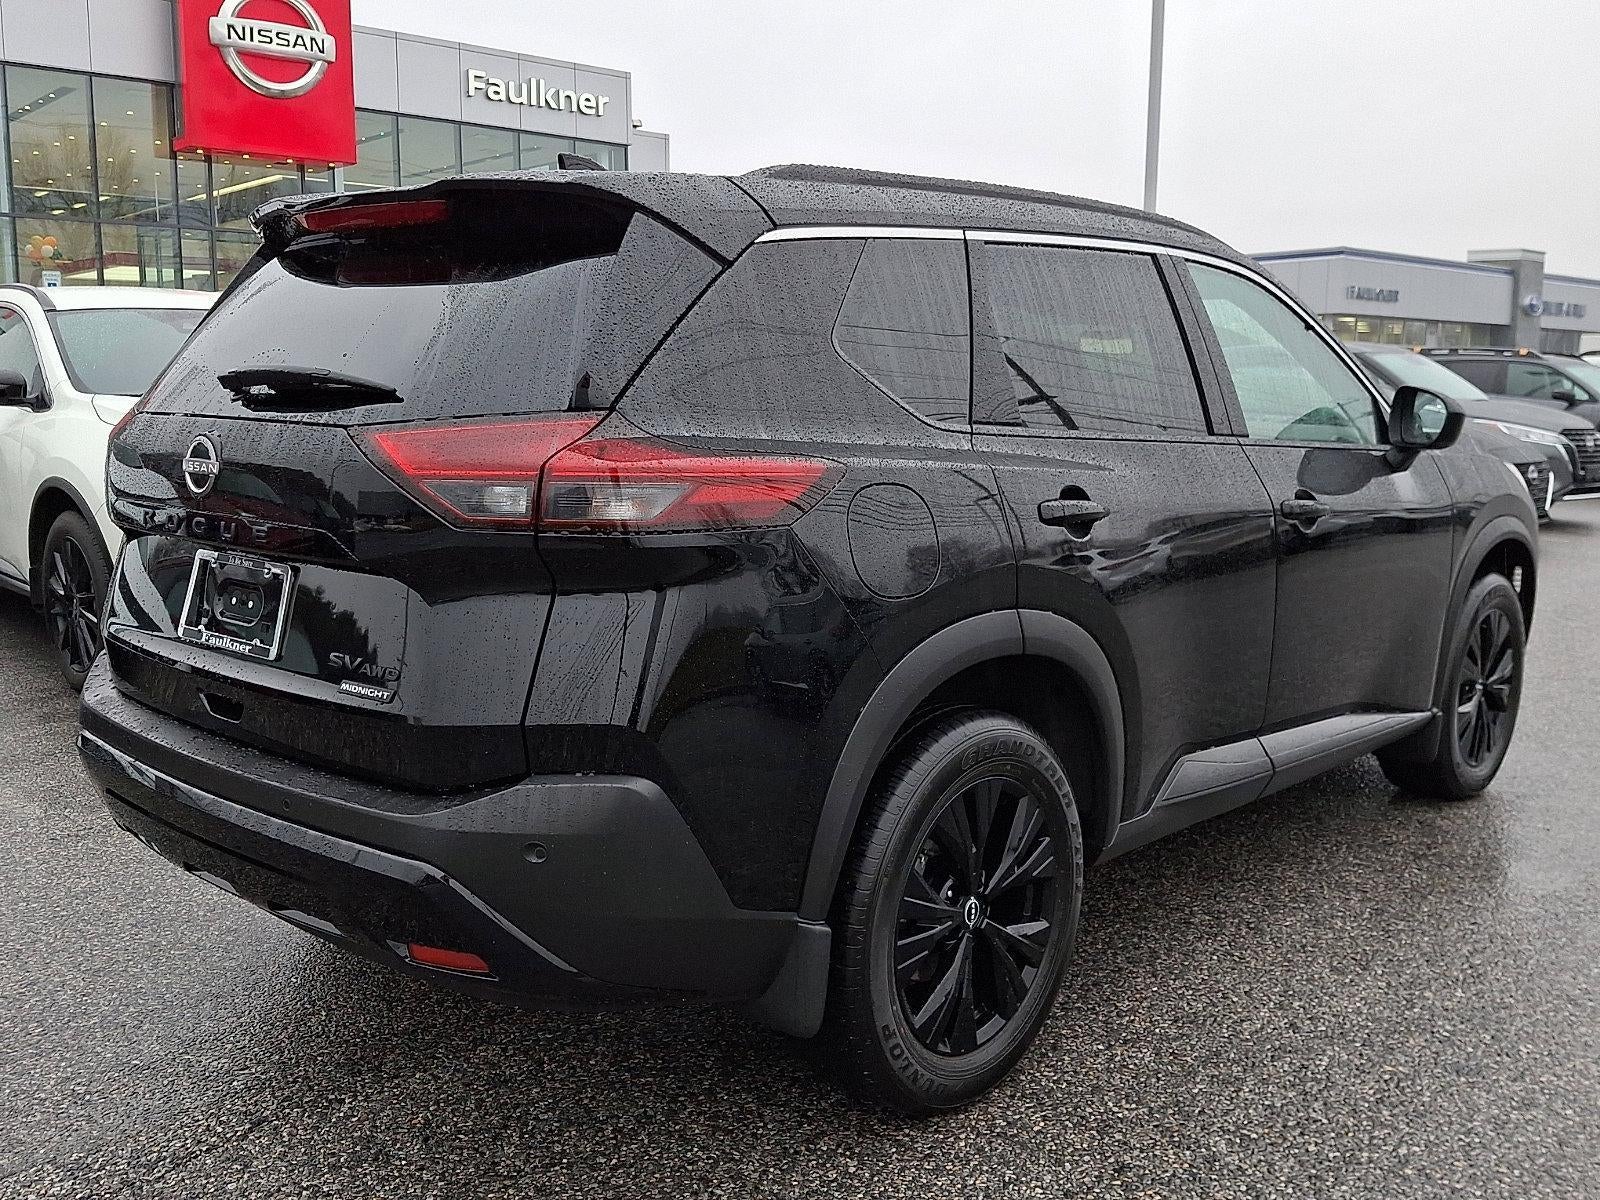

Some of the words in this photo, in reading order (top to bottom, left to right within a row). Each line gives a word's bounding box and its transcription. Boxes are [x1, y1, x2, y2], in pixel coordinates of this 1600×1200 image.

[226, 23, 325, 54] NISSAN
[467, 68, 610, 116] Faulkner
[142, 509, 269, 543] ROGUE
[201, 632, 253, 654] Faulkner
[327, 652, 363, 670] SV
[359, 662, 399, 681] AWD
[339, 682, 391, 700] MIDNIGHT
